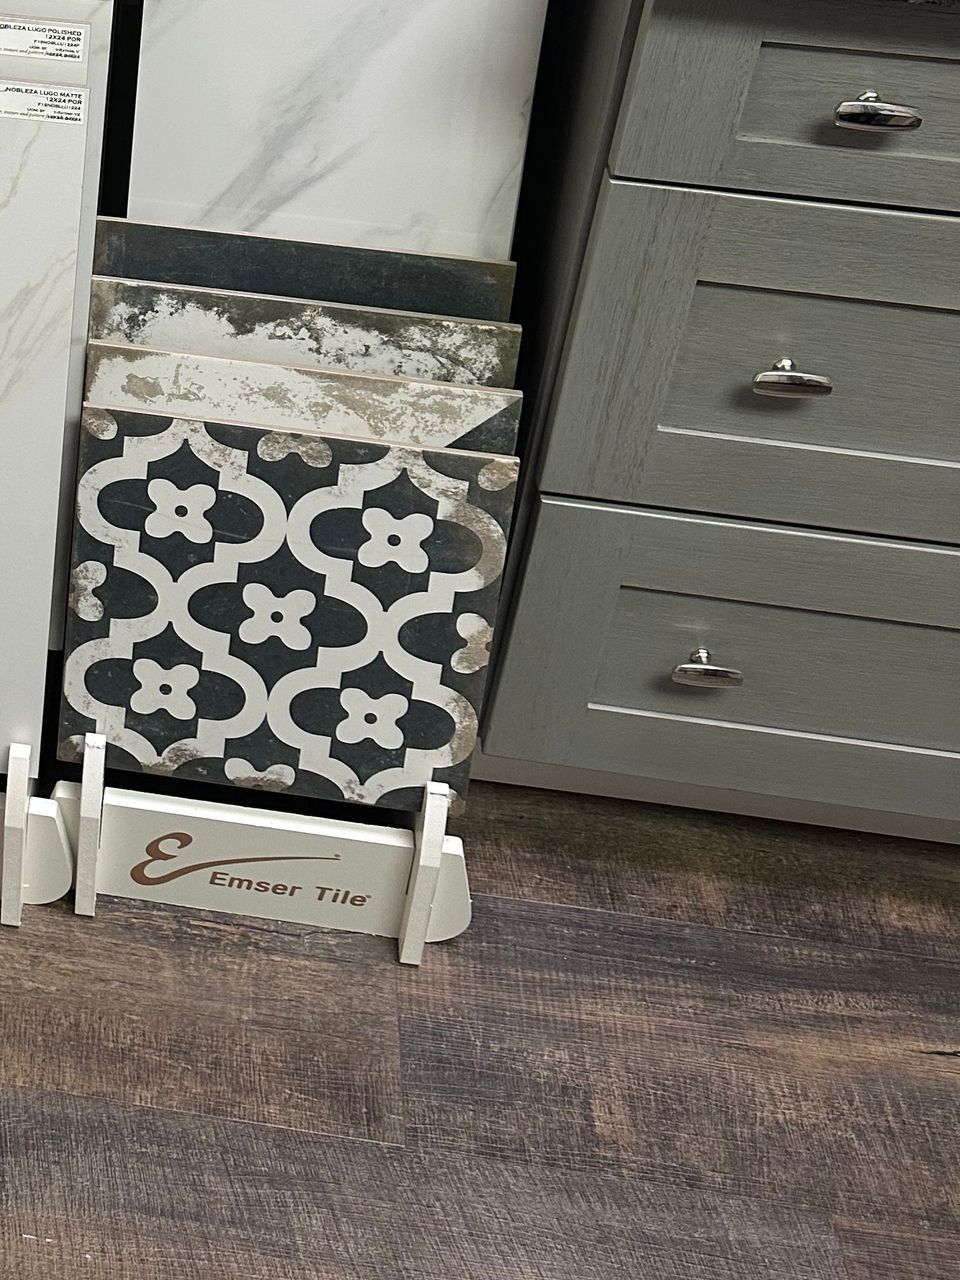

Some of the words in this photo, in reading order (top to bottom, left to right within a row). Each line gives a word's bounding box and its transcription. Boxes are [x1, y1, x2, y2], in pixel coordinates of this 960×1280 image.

[48, 28, 82, 36] POLISHED
[208, 871, 304, 897] Emser
[315, 886, 369, 907] Tile
